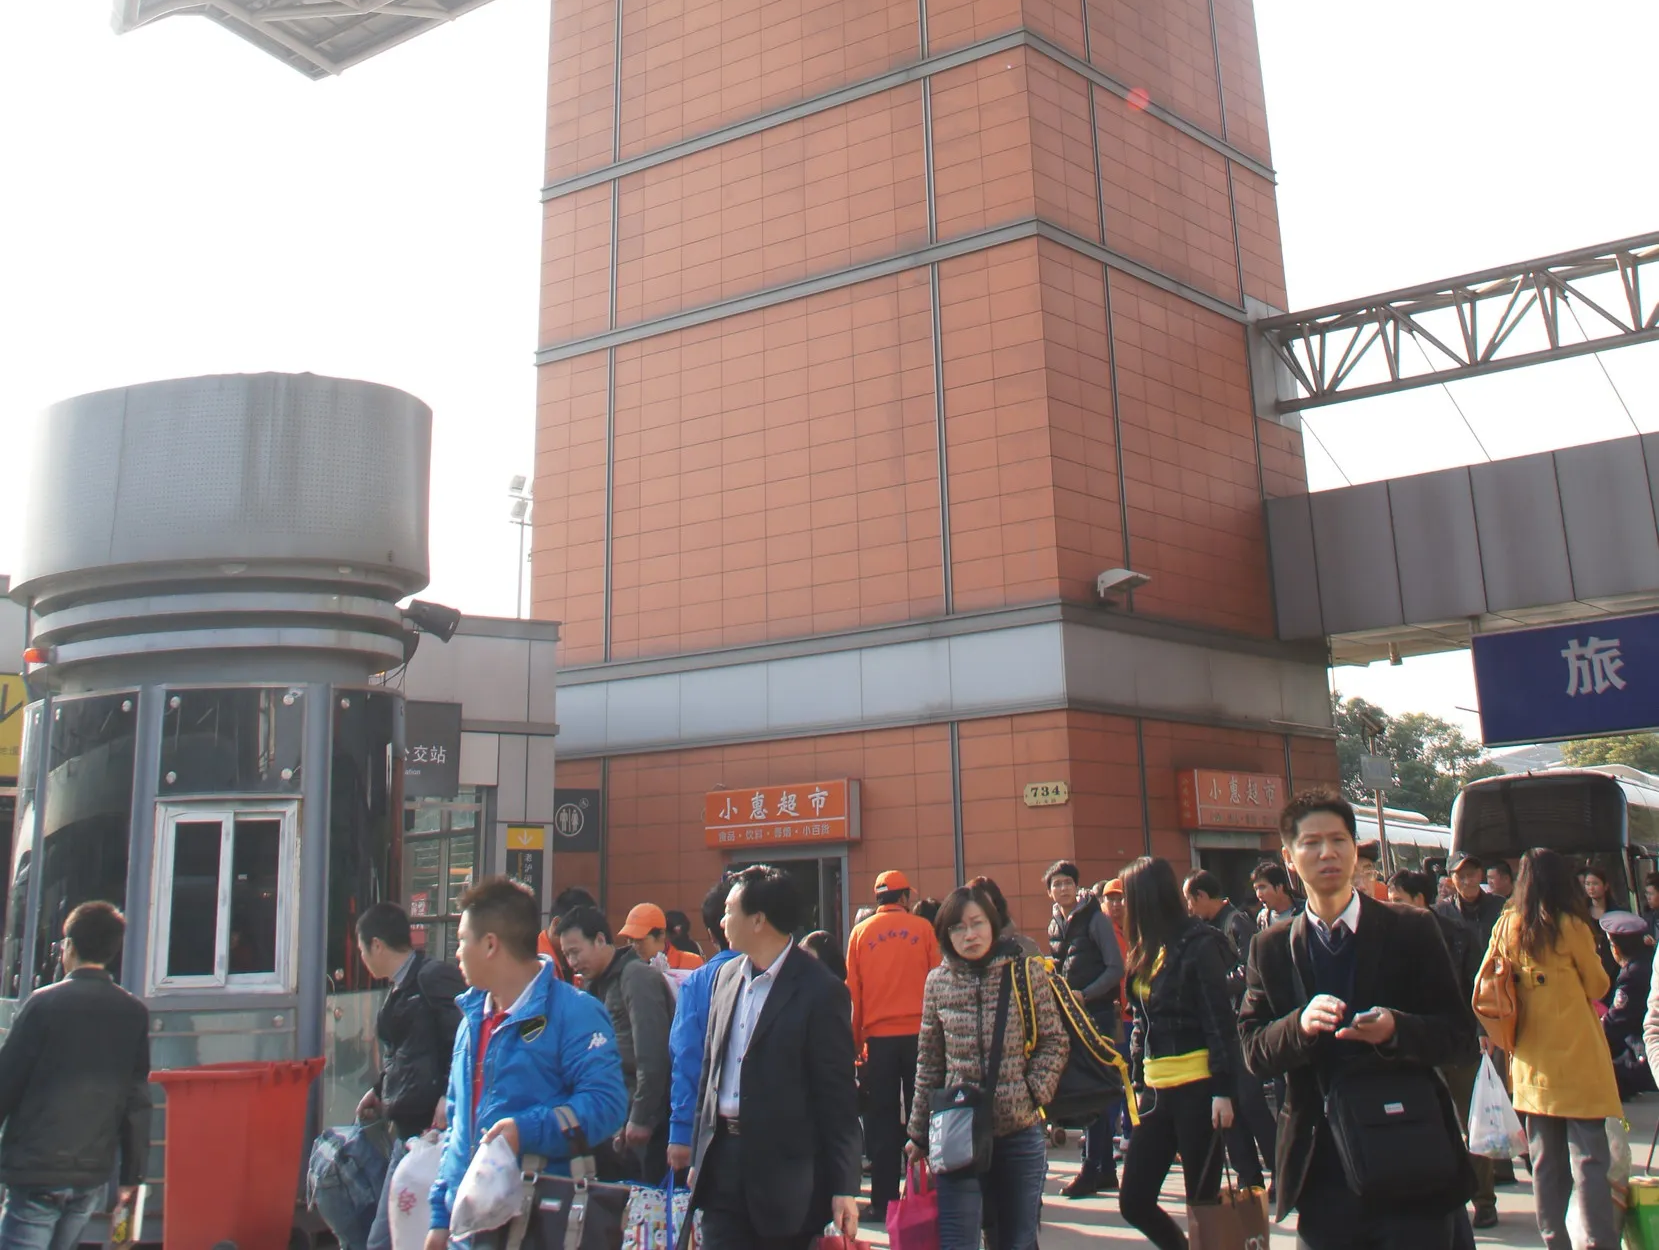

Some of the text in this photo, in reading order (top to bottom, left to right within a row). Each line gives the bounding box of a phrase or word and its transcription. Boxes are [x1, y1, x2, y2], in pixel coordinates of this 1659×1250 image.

[1561, 636, 1627, 698] 旅
[719, 786, 829, 821] 小惠超市
[1030, 785, 1061, 798] 734
[1209, 775, 1276, 807] 小惠超市
